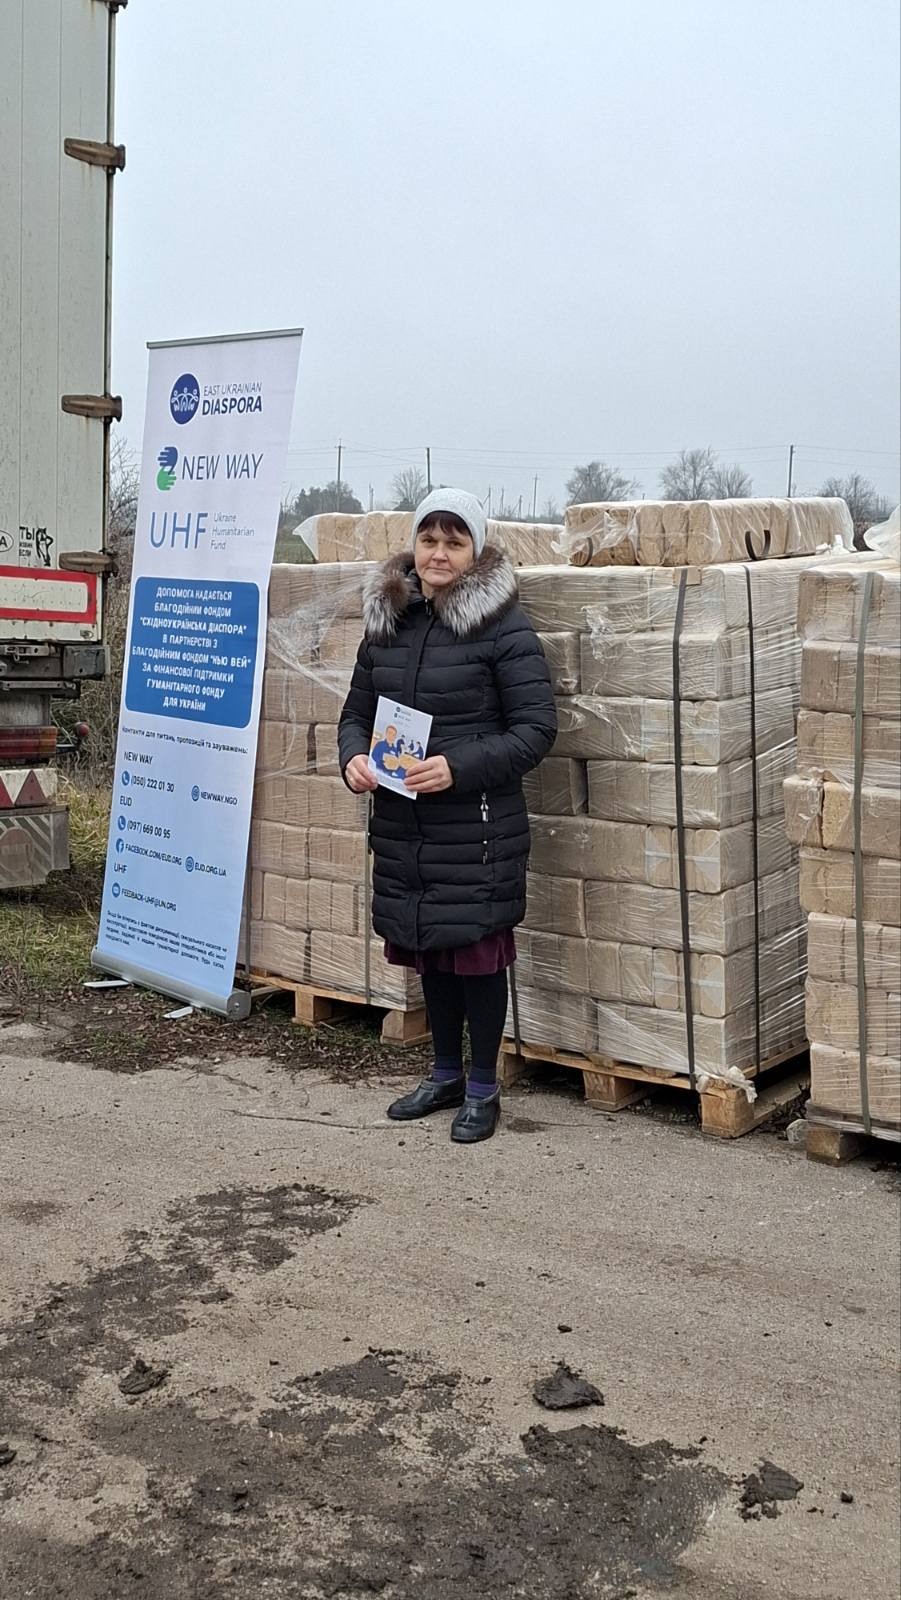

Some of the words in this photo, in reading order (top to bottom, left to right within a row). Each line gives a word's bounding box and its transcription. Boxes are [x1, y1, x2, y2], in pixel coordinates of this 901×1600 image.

[203, 384, 220, 396] EAST
[222, 382, 262, 395] UKRAINIAN
[202, 395, 263, 416] DIASPORA
[182, 455, 221, 481] NEW
[226, 453, 264, 479] WAY
[213, 513, 237, 523] Ukraine
[150, 511, 208, 549] UHF
[212, 527, 255, 537] Humanitarian
[210, 541, 226, 550] Fund
[156, 587, 195, 600] ДОПОМОГА
[195, 589, 232, 602] НАДАЄТЬСЯ
[154, 602, 202, 615] БЛАГОДІЙНИМ
[203, 606, 231, 617] ФОНДОМ
[162, 634, 167, 644] В
[169, 635, 212, 648] ПАРТНЕРСТВІ
[213, 639, 218, 648] З
[132, 646, 181, 659] БЛАГОДІЙНИМ
[181, 653, 209, 664] ФОНДОМ
[142, 663, 152, 672] ЗА
[153, 665, 193, 678] ФІНАНСОВОЇ
[194, 669, 234, 683] ПІДТРИМКИ
[146, 678, 200, 694] ГУМАНІТАРНОГО
[201, 686, 225, 698] ФОНДУ
[163, 697, 178, 708] ДЛЯ
[179, 698, 206, 712] УКРАЇНИ
[146, 731, 155, 739] для
[124, 751, 138, 763] NEW
[139, 753, 153, 765] WAY
[130, 775, 146, 787] (050)
[147, 778, 158, 789] 222
[159, 780, 165, 790] 01
[167, 782, 175, 793] 30
[119, 796, 133, 807] EUD
[200, 791, 238, 806] NEWWAY.NGO
[127, 820, 142, 833] (097)
[142, 824, 153, 835] 669
[154, 827, 162, 837] 00
[163, 829, 171, 839] 95
[114, 862, 128, 874] UHF
[194, 862, 227, 877] EUD.ORG.UA
[121, 888, 177, 912] FEEDBACK-UHF@UN.ORG
